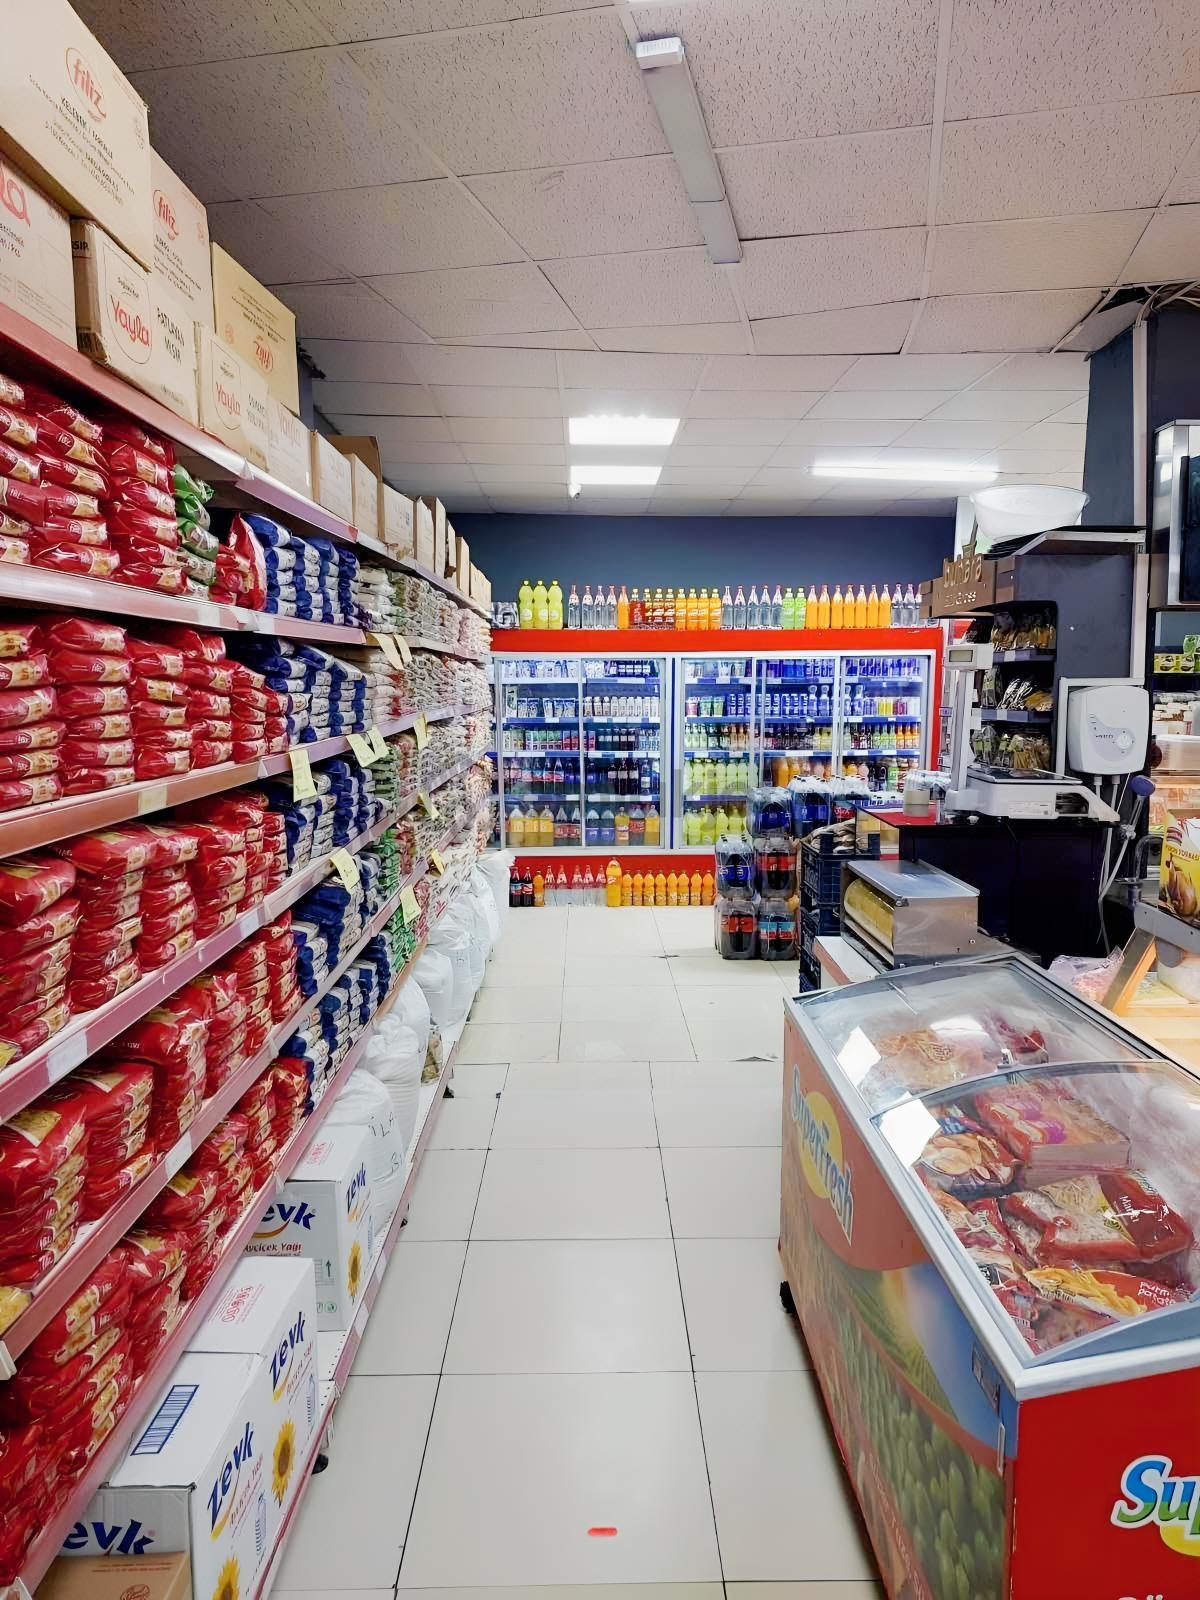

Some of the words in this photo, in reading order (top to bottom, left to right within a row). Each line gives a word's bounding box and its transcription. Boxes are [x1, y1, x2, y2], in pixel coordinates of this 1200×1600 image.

[110, 294, 150, 347] Yayla
[262, 1202, 316, 1230] evk
[61, 1518, 155, 1555] evk
